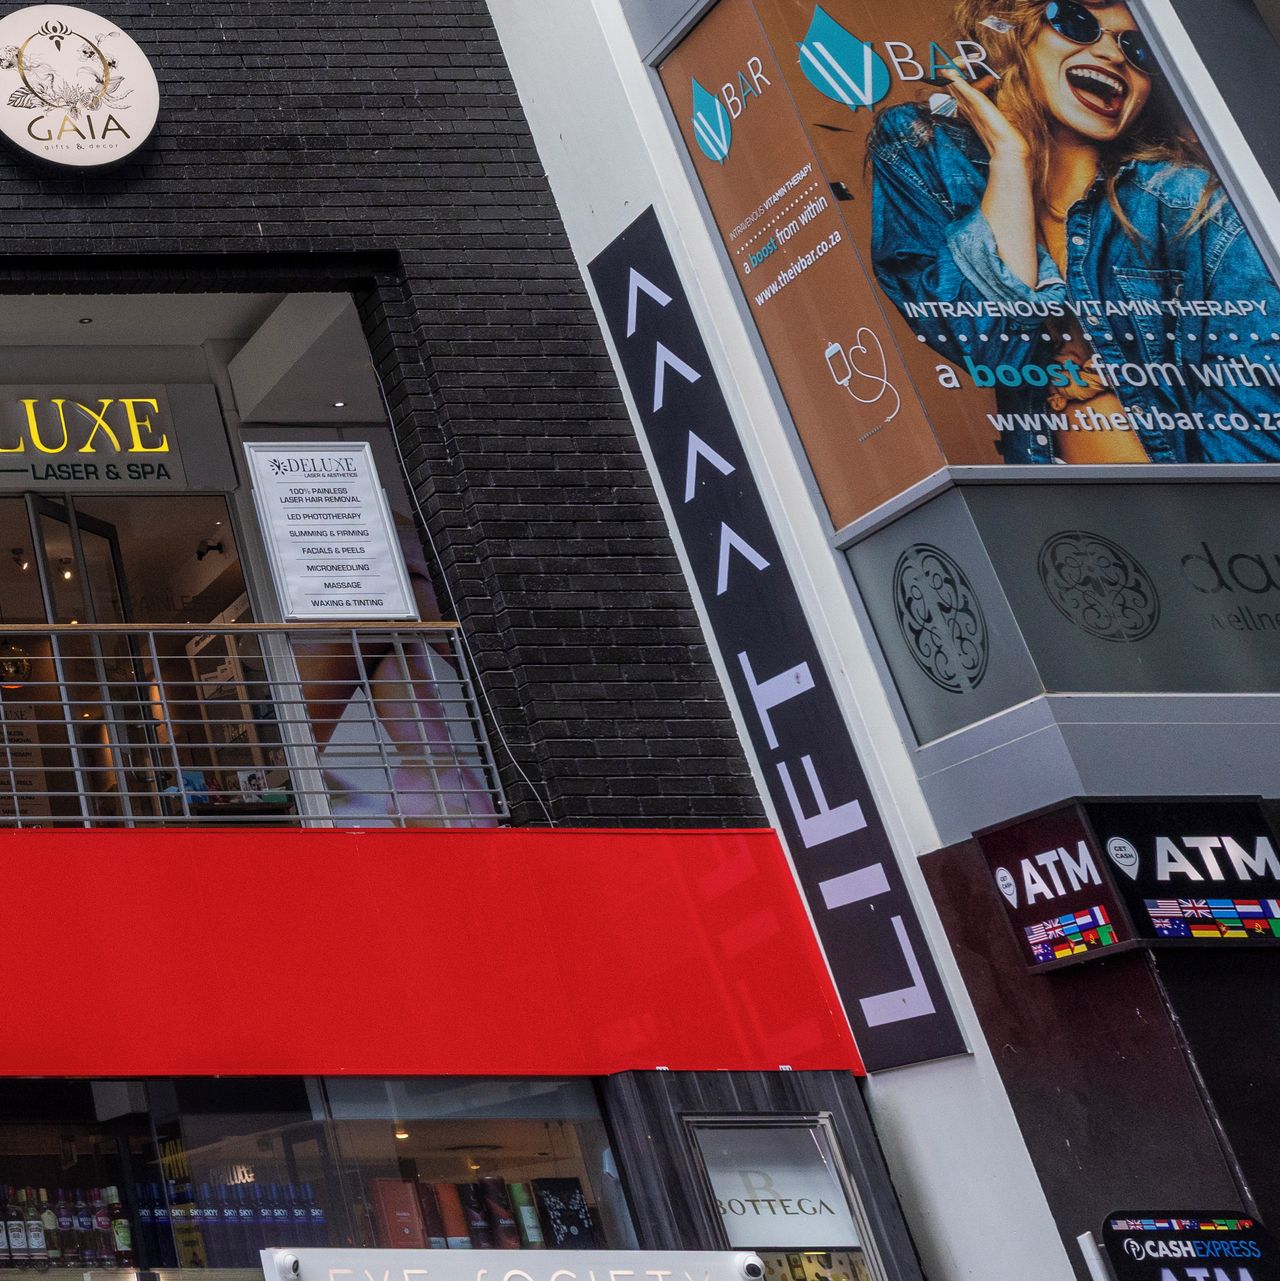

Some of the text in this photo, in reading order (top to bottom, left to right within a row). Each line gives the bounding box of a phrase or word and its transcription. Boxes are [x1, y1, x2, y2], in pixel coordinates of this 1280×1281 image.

[883, 40, 1001, 81] BAR
[720, 56, 771, 121] BAR
[27, 114, 131, 141] GAIA
[729, 163, 813, 240] INTRAVENOUS VITAMIN THERAPY
[743, 194, 828, 274] a boost from within
[755, 230, 842, 307] www.theivbar.co.za
[903, 300, 1268, 318] INTRAVENOUS VITAMIN THERAPY
[935, 354, 1280, 389] a boost from withi
[32, 463, 172, 481] LASER & SPA
[287, 457, 357, 472] DELUXE
[280, 496, 304, 504] LASER
[289, 487, 348, 495] 100% PAINLESS
[289, 530, 329, 538] SLIMMING
[302, 547, 333, 555] FACIALS
[307, 564, 370, 572] MICRONEEDLING
[1181, 541, 1280, 594] da
[737, 651, 936, 1028] LIFT
[1115, 852, 1135, 860] CASH
[1156, 836, 1280, 881] ATM
[1020, 840, 1102, 905] ATM
